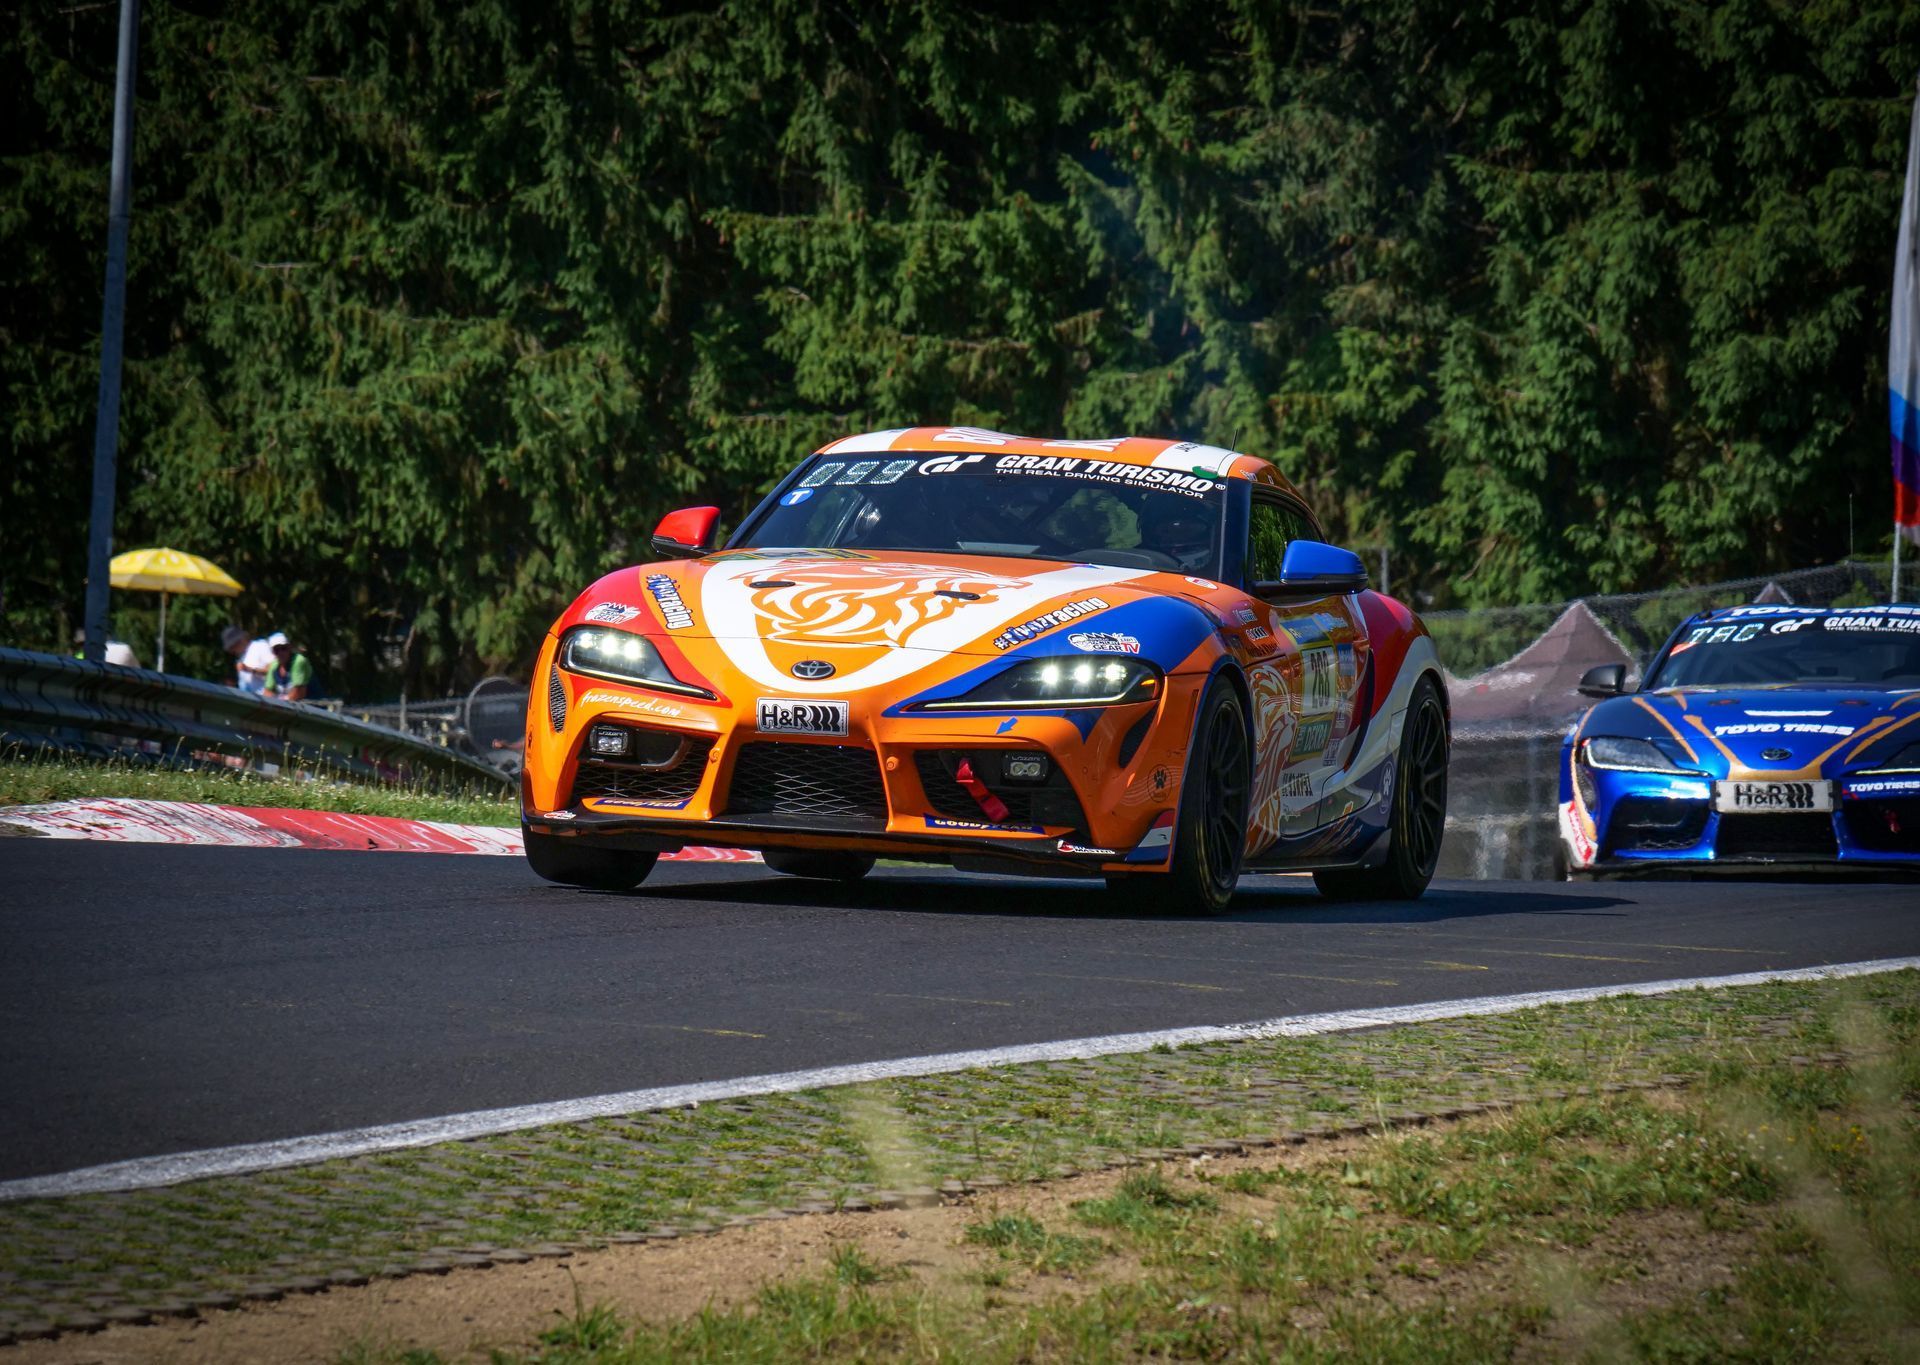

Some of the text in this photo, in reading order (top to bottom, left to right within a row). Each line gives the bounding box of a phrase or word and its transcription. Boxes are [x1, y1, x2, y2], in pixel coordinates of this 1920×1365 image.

[995, 455, 1077, 472] GRAN
[1083, 460, 1214, 492] TURISMO
[1065, 472, 1121, 484] DRIVING
[1125, 479, 1205, 500] SIMULATOR
[1824, 616, 1883, 628] GRAN
[1093, 642, 1140, 654] GEAR TV
[761, 705, 809, 728] H&R
[1714, 723, 1855, 737] TOYO TIRES
[1734, 783, 1783, 807] H&R
[1849, 781, 1883, 792] TOYO
